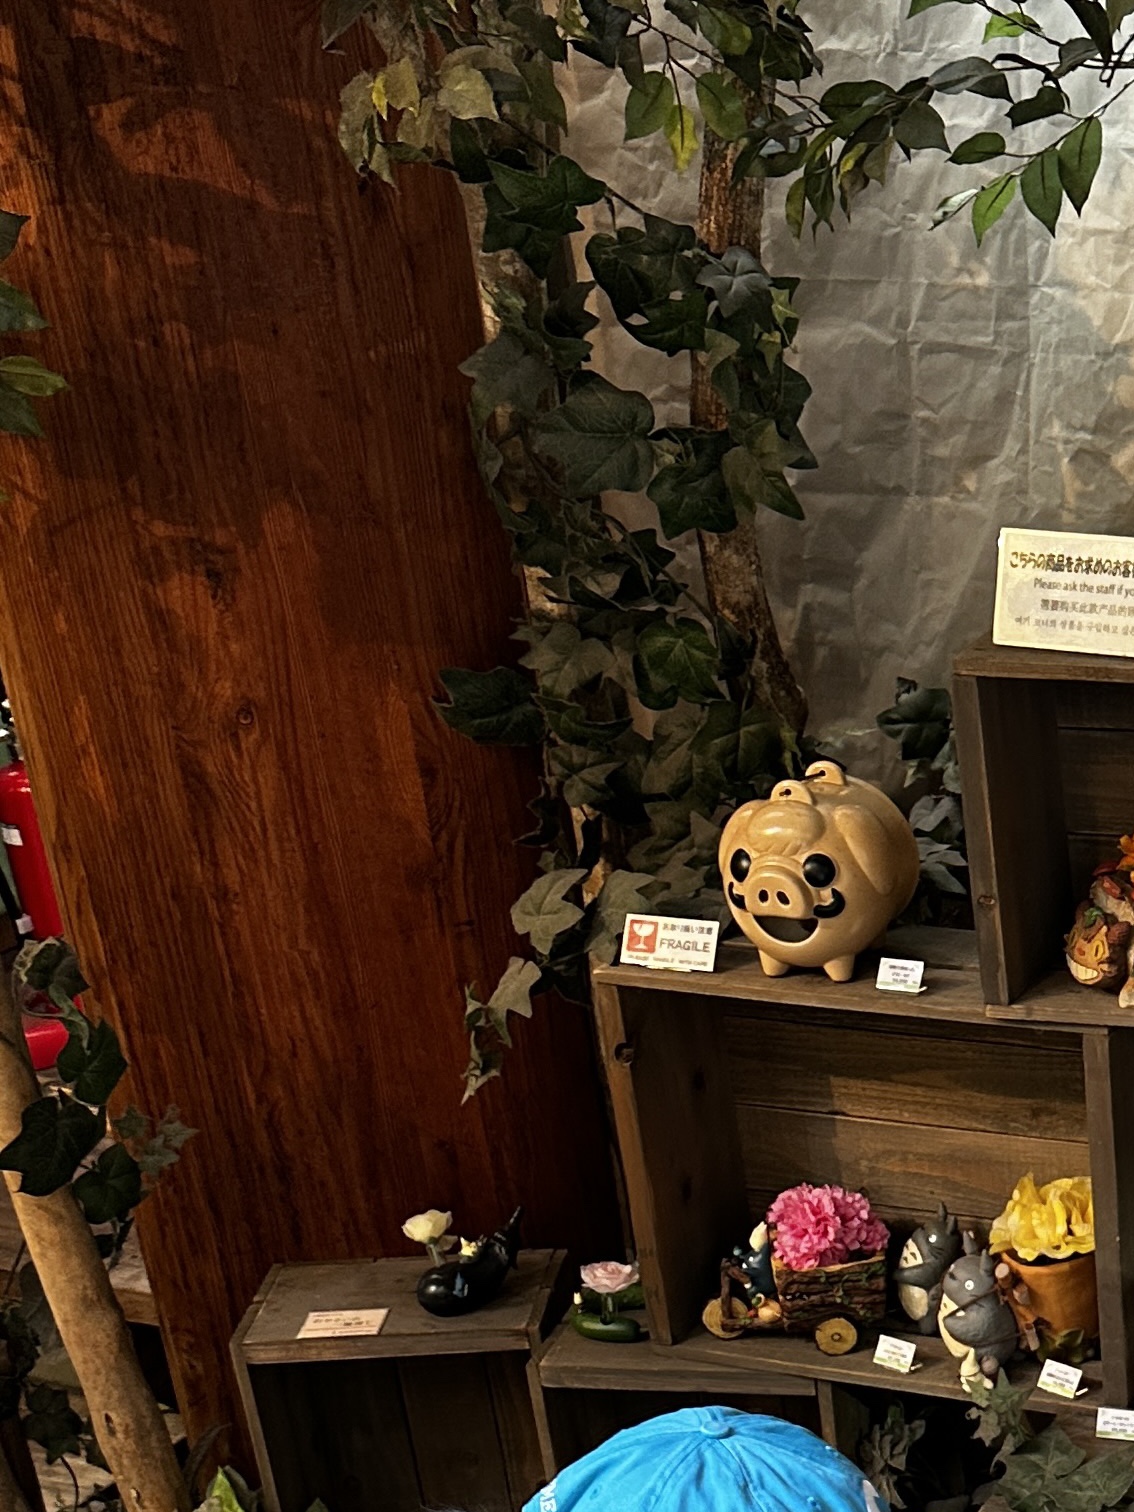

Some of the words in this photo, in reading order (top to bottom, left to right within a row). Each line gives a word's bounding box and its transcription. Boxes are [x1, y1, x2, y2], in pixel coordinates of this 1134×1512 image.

[1033, 577, 1061, 591] Please
[1062, 581, 1078, 592] ask
[1079, 582, 1095, 594] the
[1096, 583, 1116, 596] staff
[1117, 584, 1124, 595] if
[659, 937, 711, 953] FRAGILE
